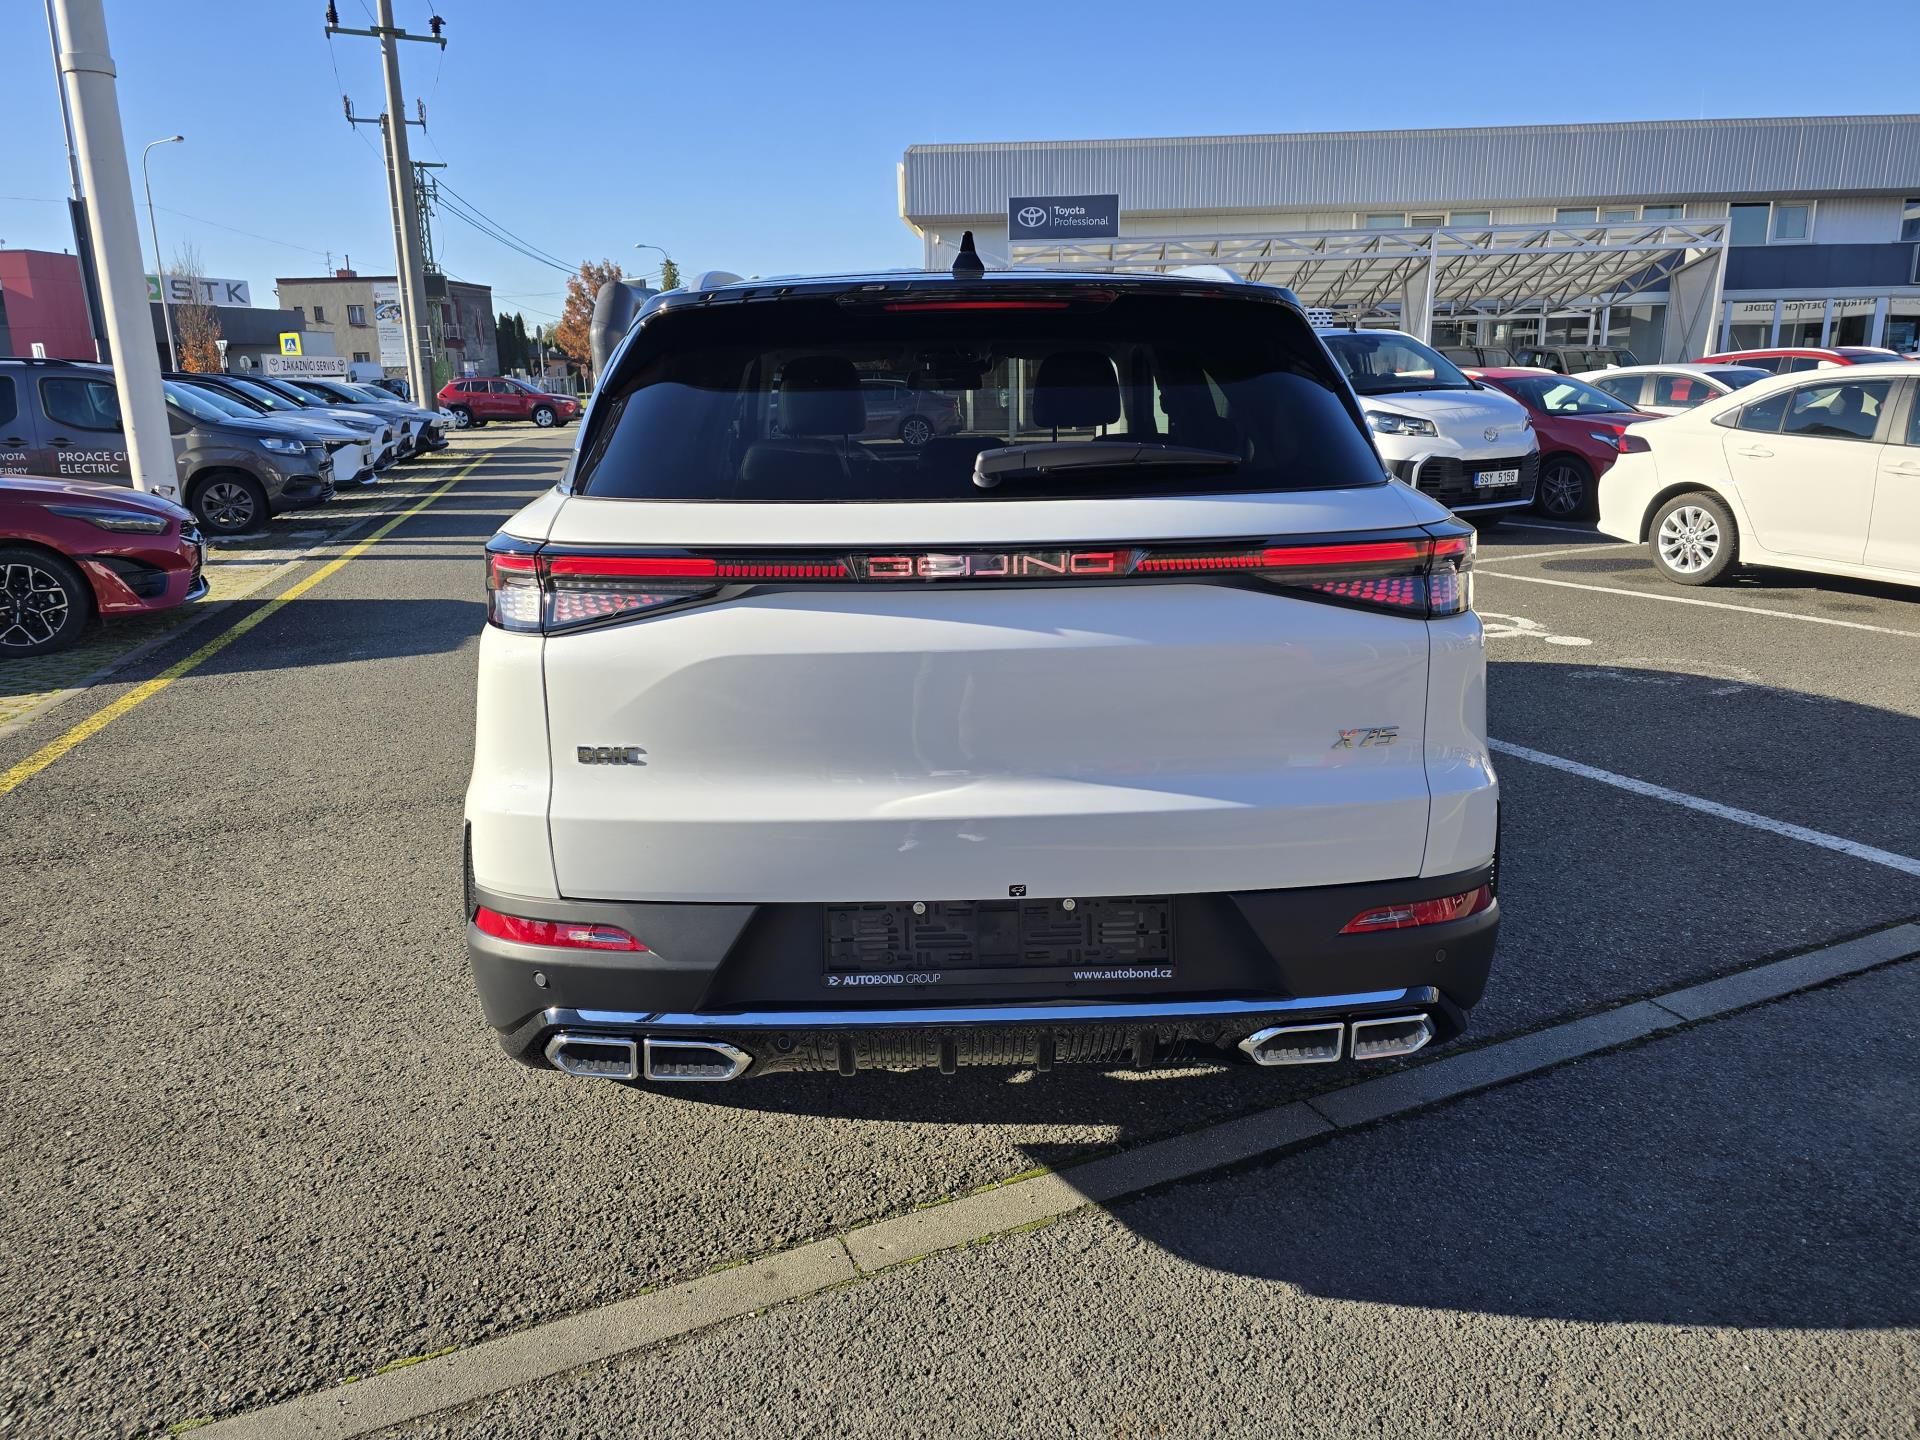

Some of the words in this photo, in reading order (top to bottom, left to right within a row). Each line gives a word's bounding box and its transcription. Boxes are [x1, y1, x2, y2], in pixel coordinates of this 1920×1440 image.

[1054, 205, 1086, 217] Toyota
[1054, 216, 1109, 227] Professional
[171, 279, 247, 304] STK
[317, 360, 336, 371] SERVIS
[58, 451, 111, 462] PROACE
[60, 463, 119, 474] ELECTRIC
[1480, 472, 1494, 484] 6SY
[1498, 471, 1516, 482] 5158
[577, 746, 646, 766] BAIC
[843, 974, 904, 986] AUTOBOND
[905, 973, 941, 984] GROUP
[1073, 967, 1172, 980] www.autobond.cz
